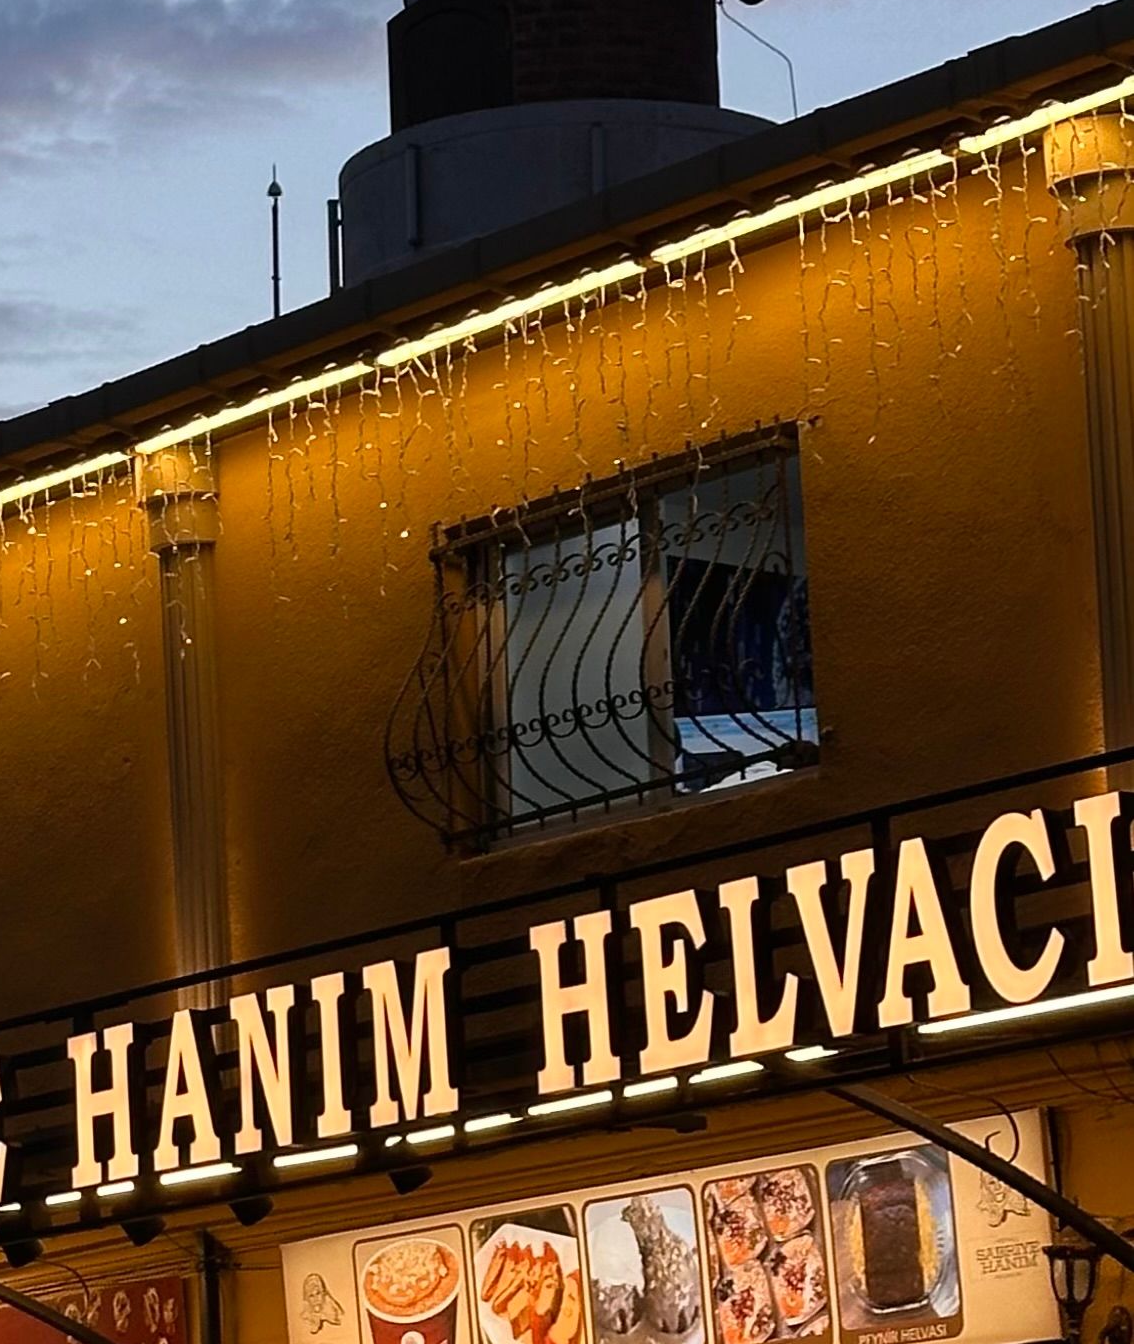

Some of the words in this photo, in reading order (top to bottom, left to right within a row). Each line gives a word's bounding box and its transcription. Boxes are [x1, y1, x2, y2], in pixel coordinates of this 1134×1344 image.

[68, 947, 460, 1189] HANIM
[529, 790, 1134, 1094] HELVACI
[900, 1323, 948, 1344] HELVASI
